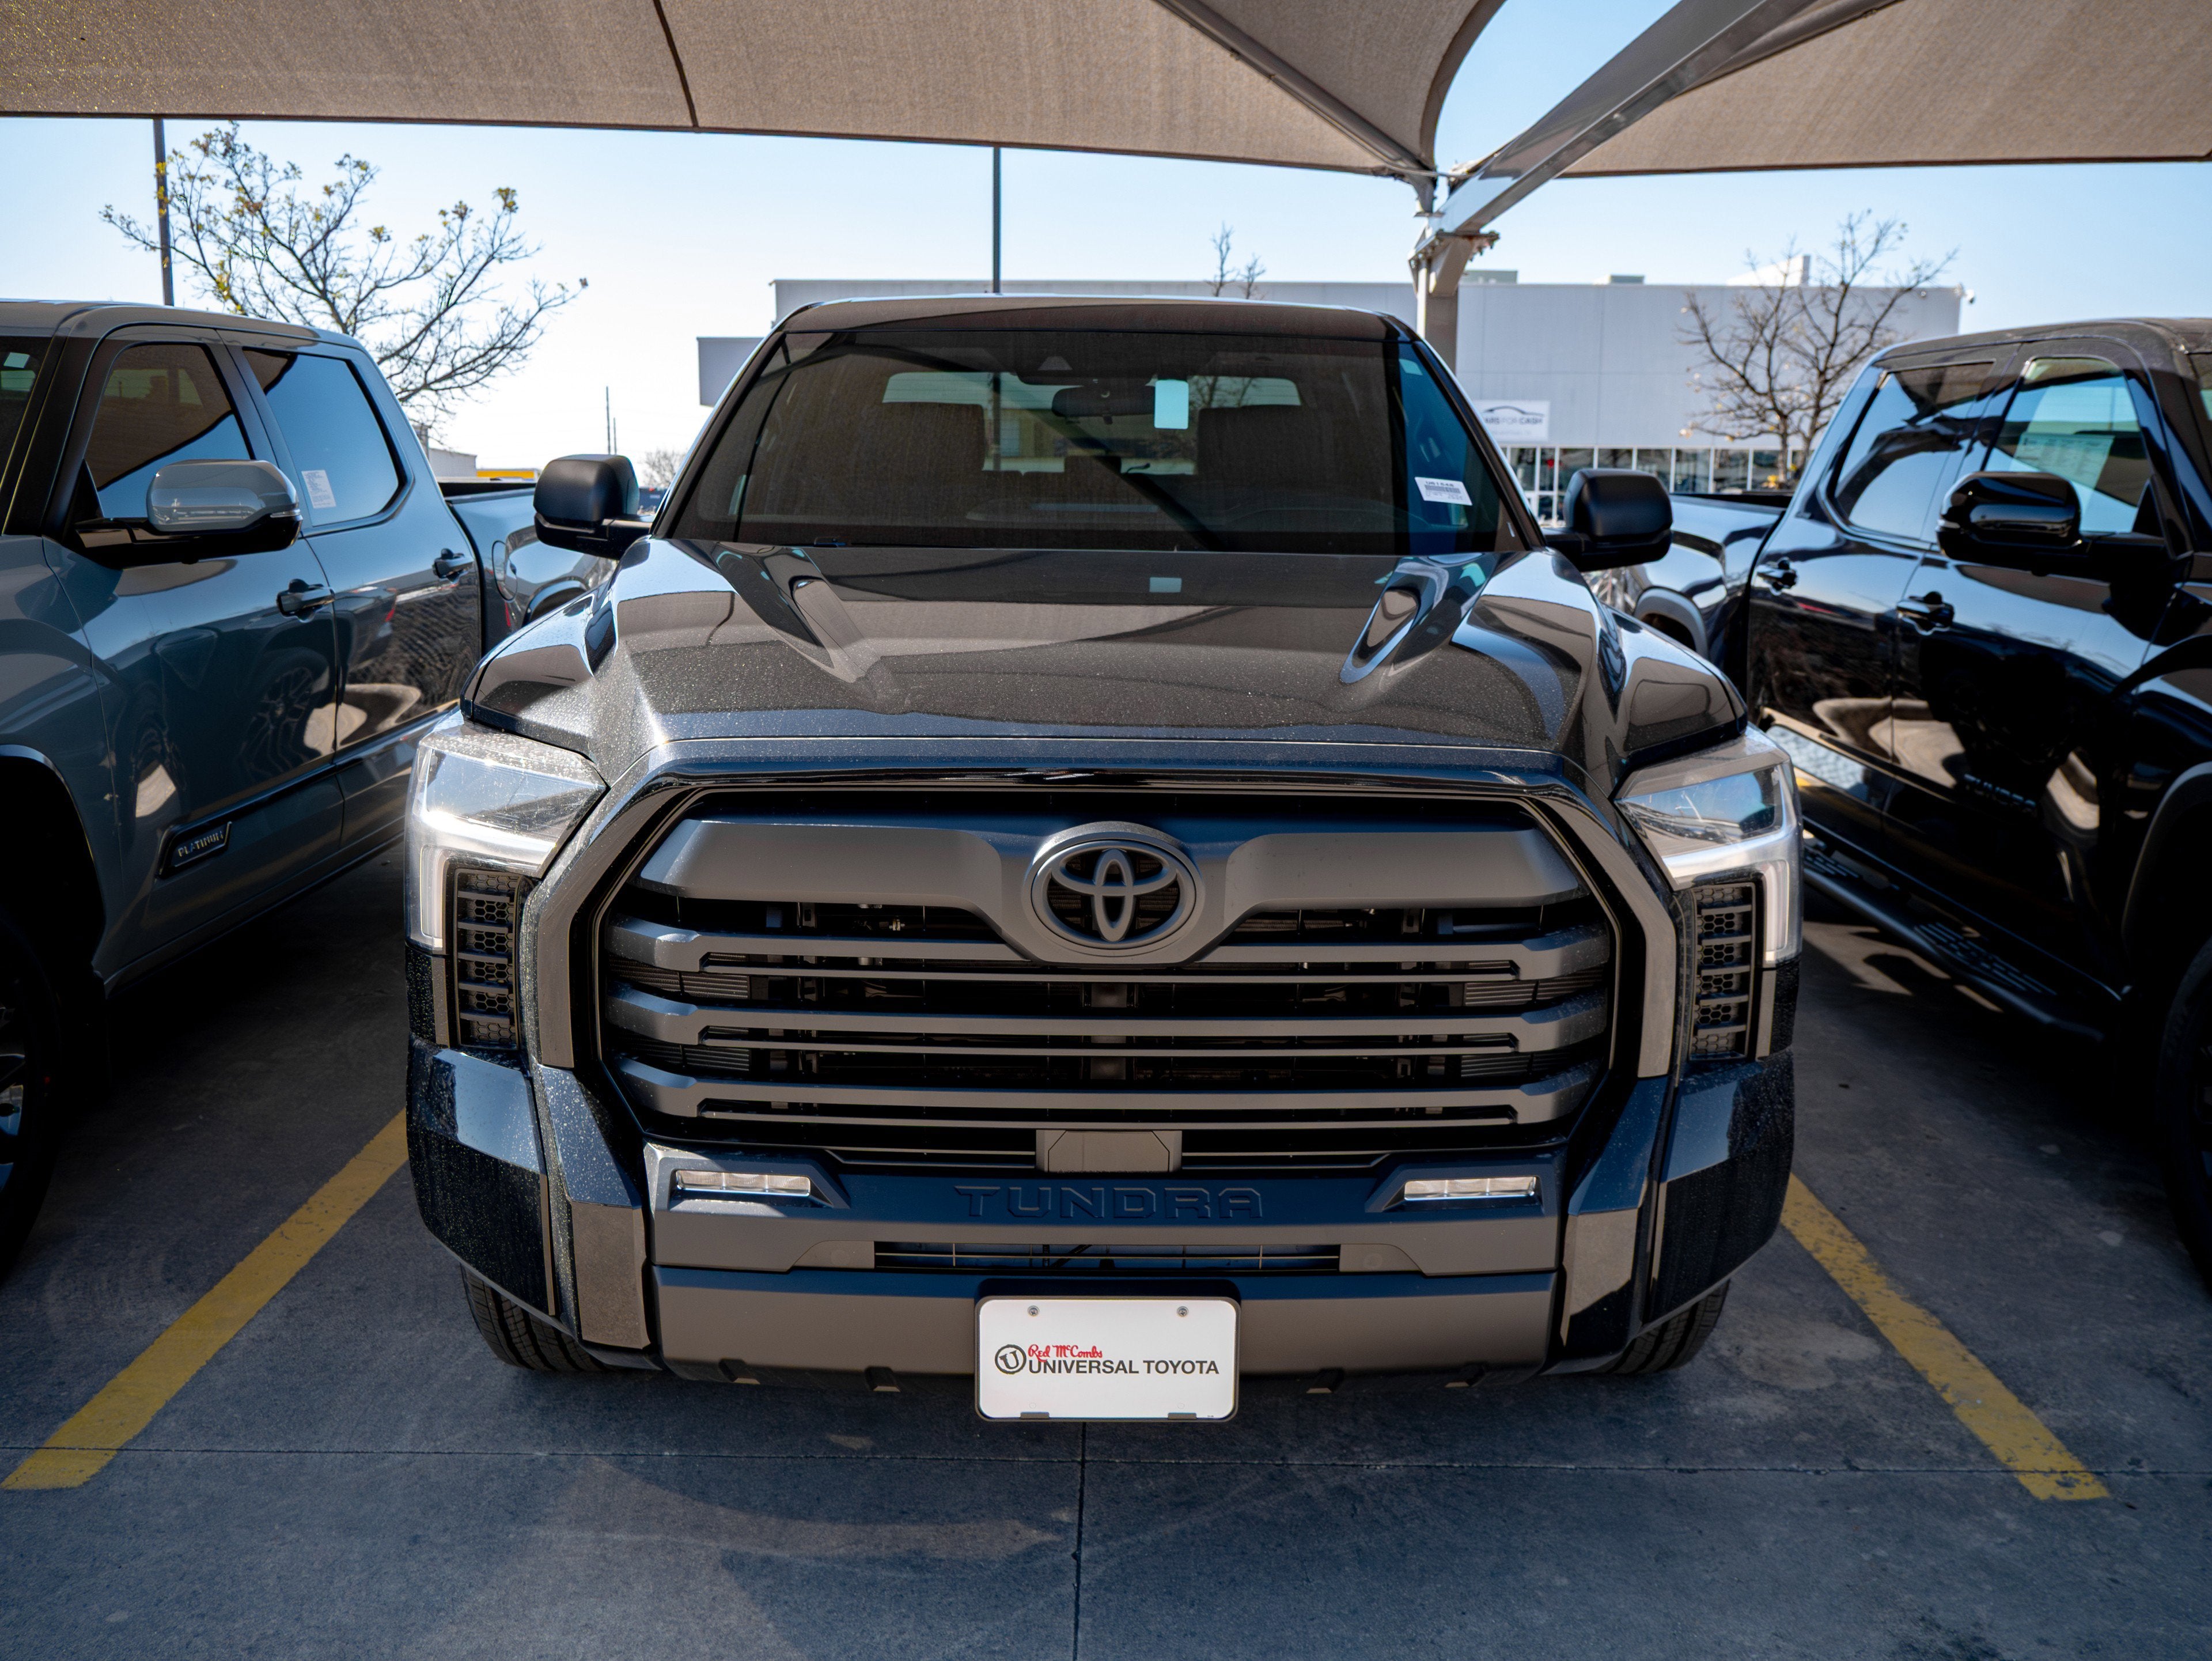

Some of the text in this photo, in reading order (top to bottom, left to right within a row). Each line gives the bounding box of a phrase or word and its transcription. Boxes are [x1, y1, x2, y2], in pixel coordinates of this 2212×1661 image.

[177, 830, 224, 857] PLATINUM
[953, 1185, 1263, 1219] TUNDRA
[1028, 1344, 1103, 1363] Red McCombs
[1029, 1360, 1220, 1375] UNIVERSAL TOYOTA
